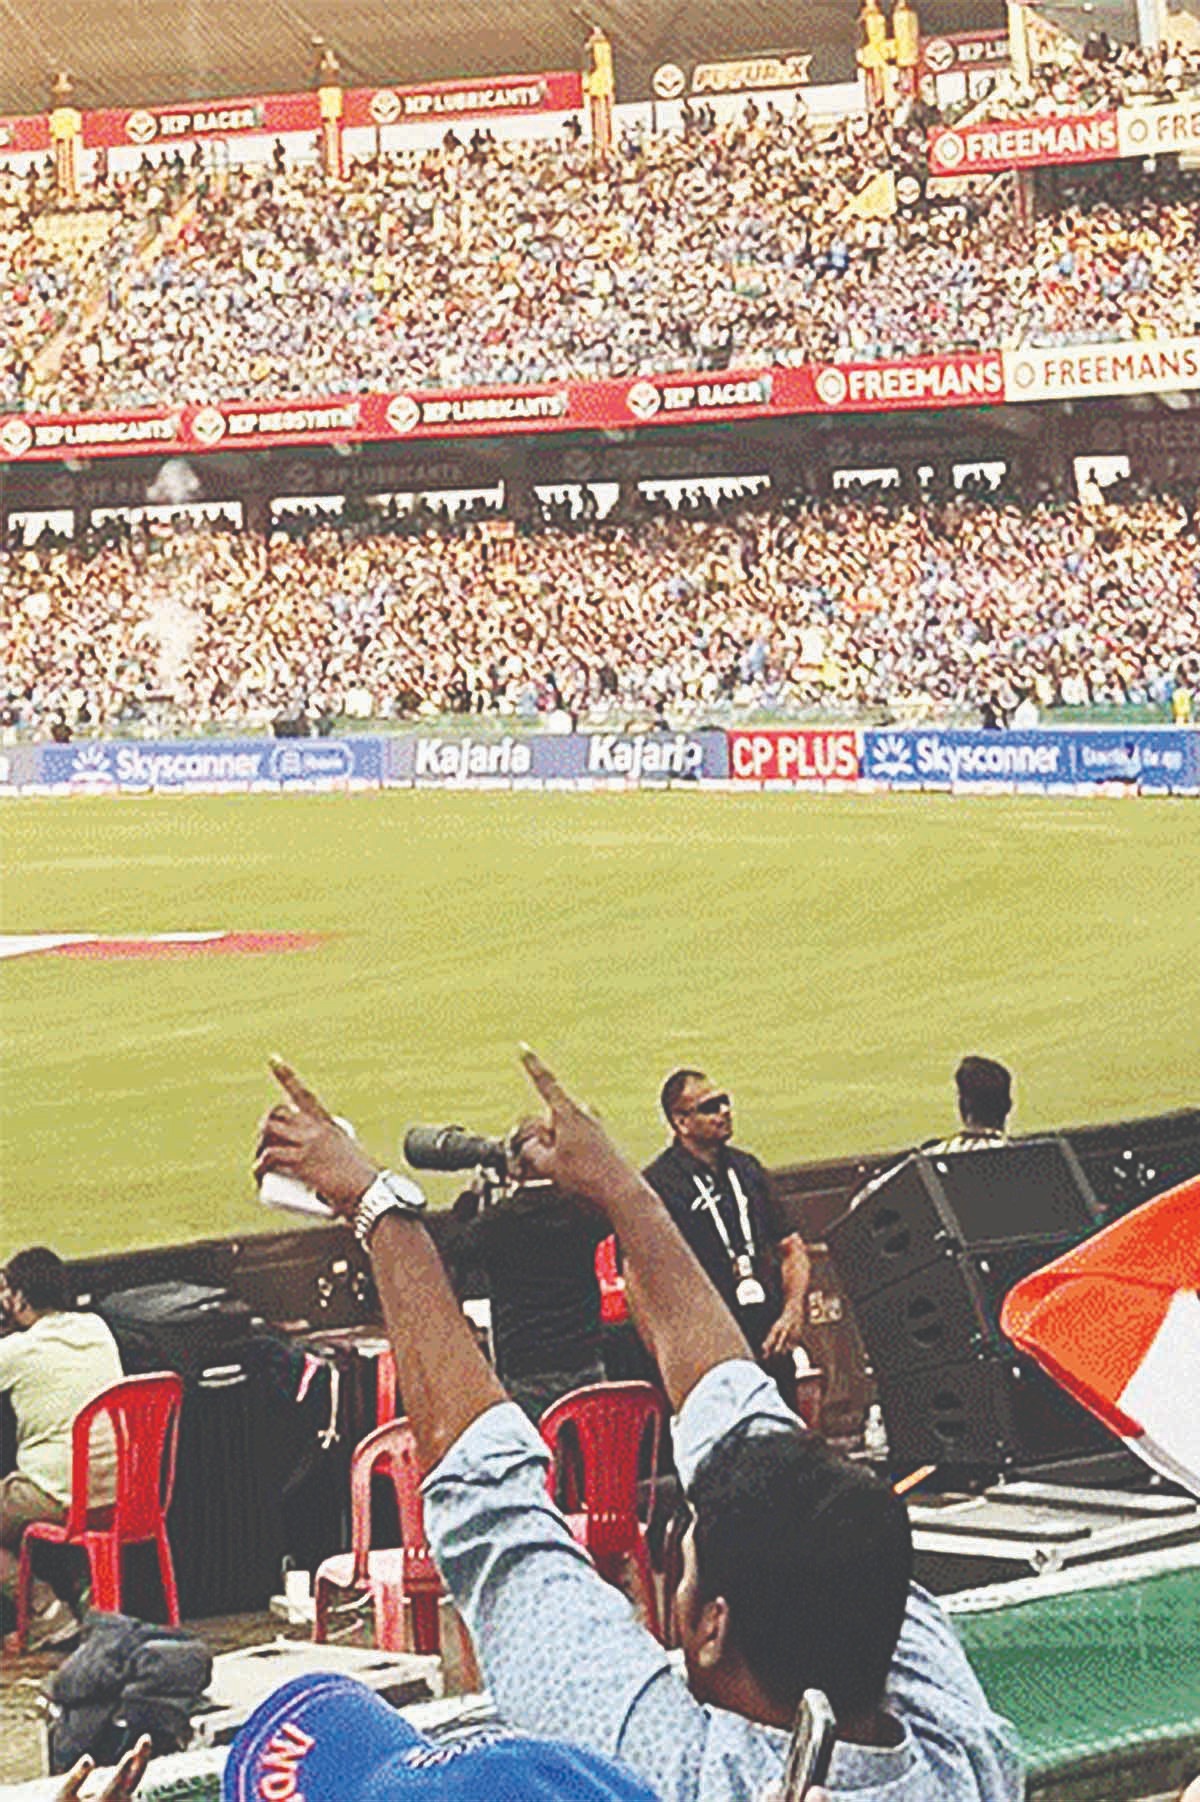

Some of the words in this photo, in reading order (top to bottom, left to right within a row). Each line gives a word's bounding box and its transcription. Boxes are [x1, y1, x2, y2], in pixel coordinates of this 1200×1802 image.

[966, 119, 1117, 162] FREEMANS
[848, 361, 1001, 401] FREEMANS
[1044, 348, 1199, 387] FREEMANS
[698, 382, 762, 406] RACER
[115, 750, 262, 785] Skyscanner
[414, 736, 532, 781] Kajaria
[733, 736, 773, 776] CP
[777, 735, 856, 777] PLUS
[917, 737, 1060, 781] Skyscanner
[258, 1721, 316, 1802] IND
